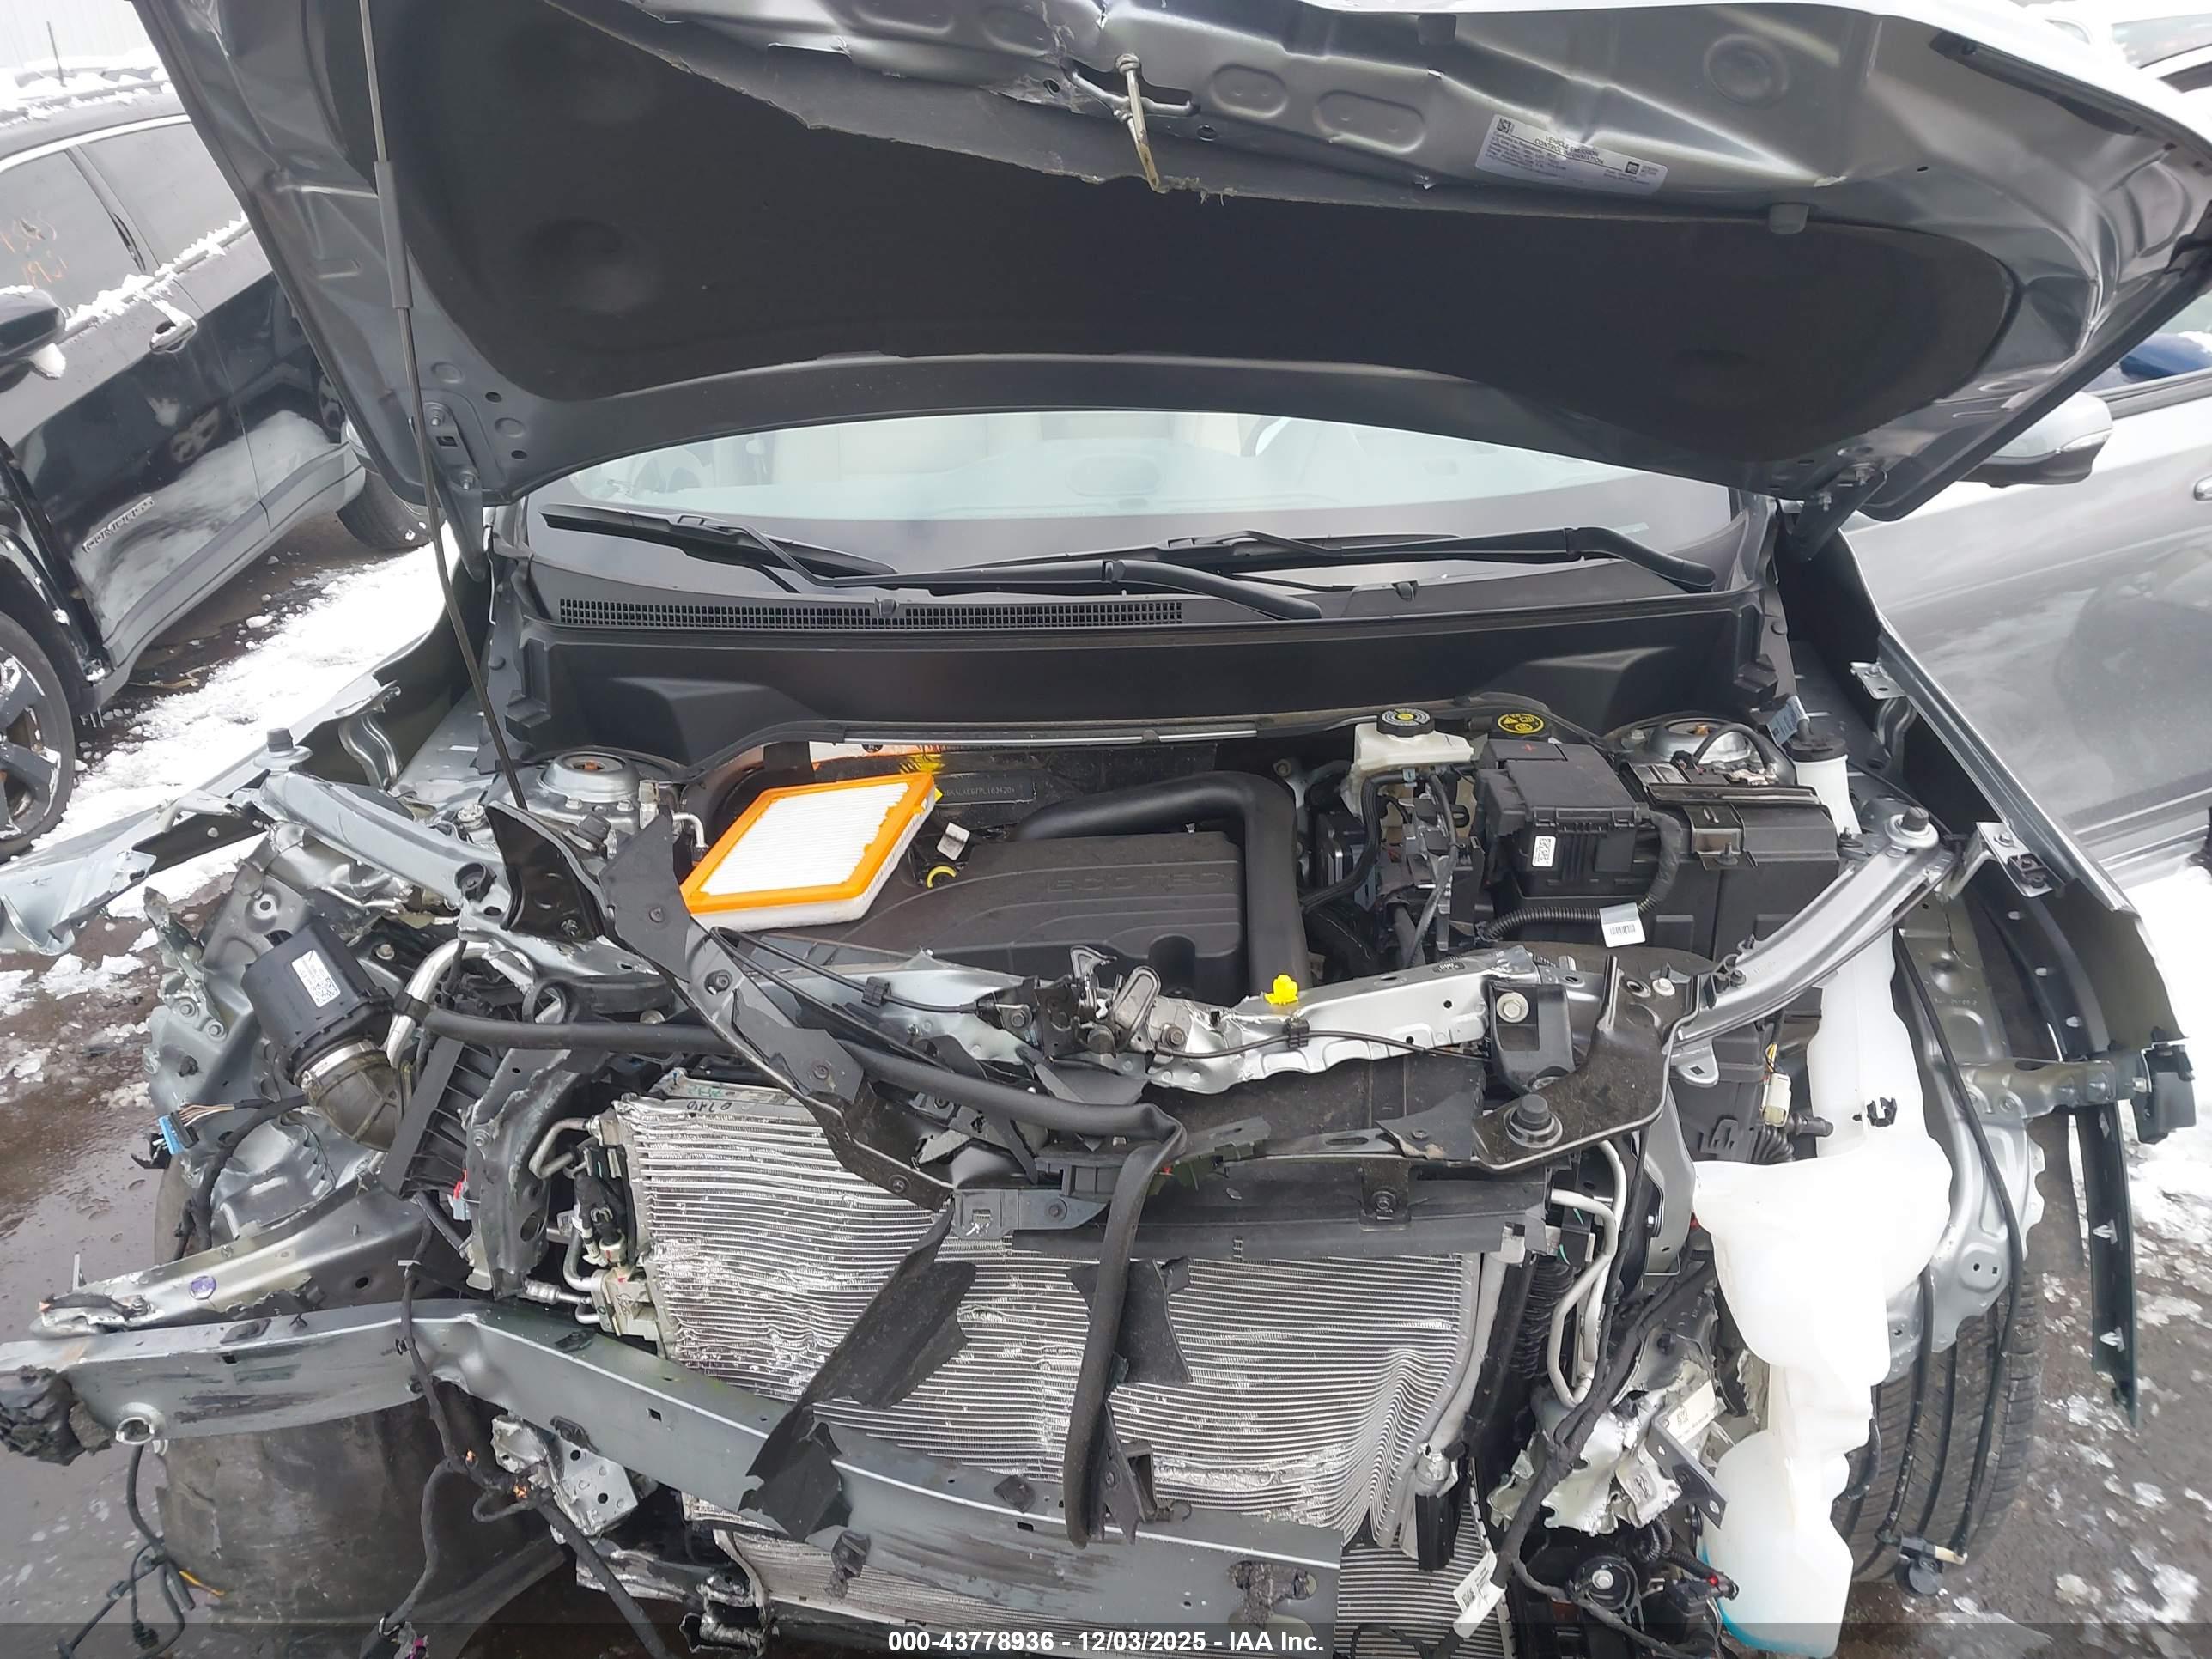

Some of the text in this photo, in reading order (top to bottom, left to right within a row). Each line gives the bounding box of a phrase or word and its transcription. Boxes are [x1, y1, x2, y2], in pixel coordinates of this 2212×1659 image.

[1534, 138, 1562, 154] CONTROL
[1545, 136, 1600, 157] VEHICLE EMISSION
